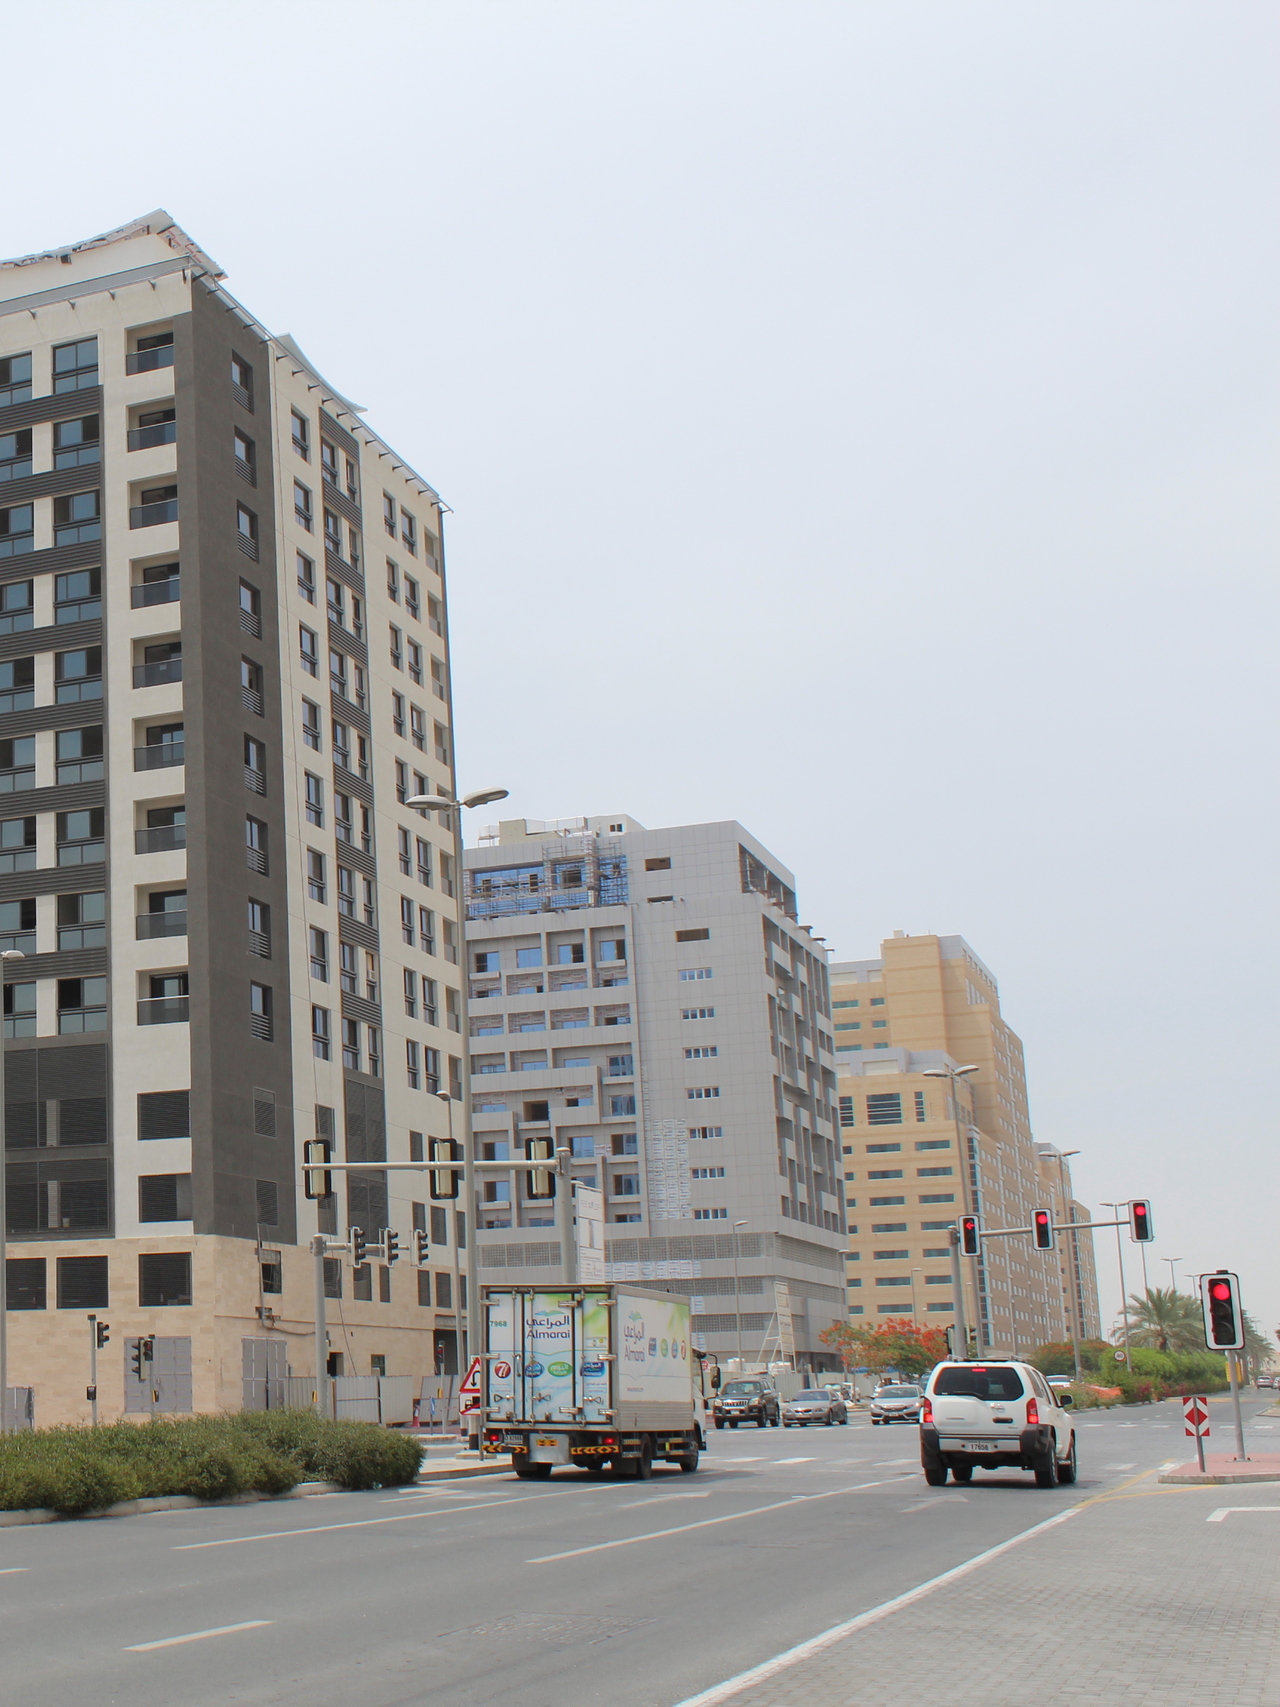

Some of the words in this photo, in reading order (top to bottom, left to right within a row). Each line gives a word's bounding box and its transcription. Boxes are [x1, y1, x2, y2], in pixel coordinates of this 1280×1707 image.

[526, 1315, 570, 1329] المراعي
[526, 1329, 570, 1339] Almarai
[624, 1345, 645, 1362] Almarai
